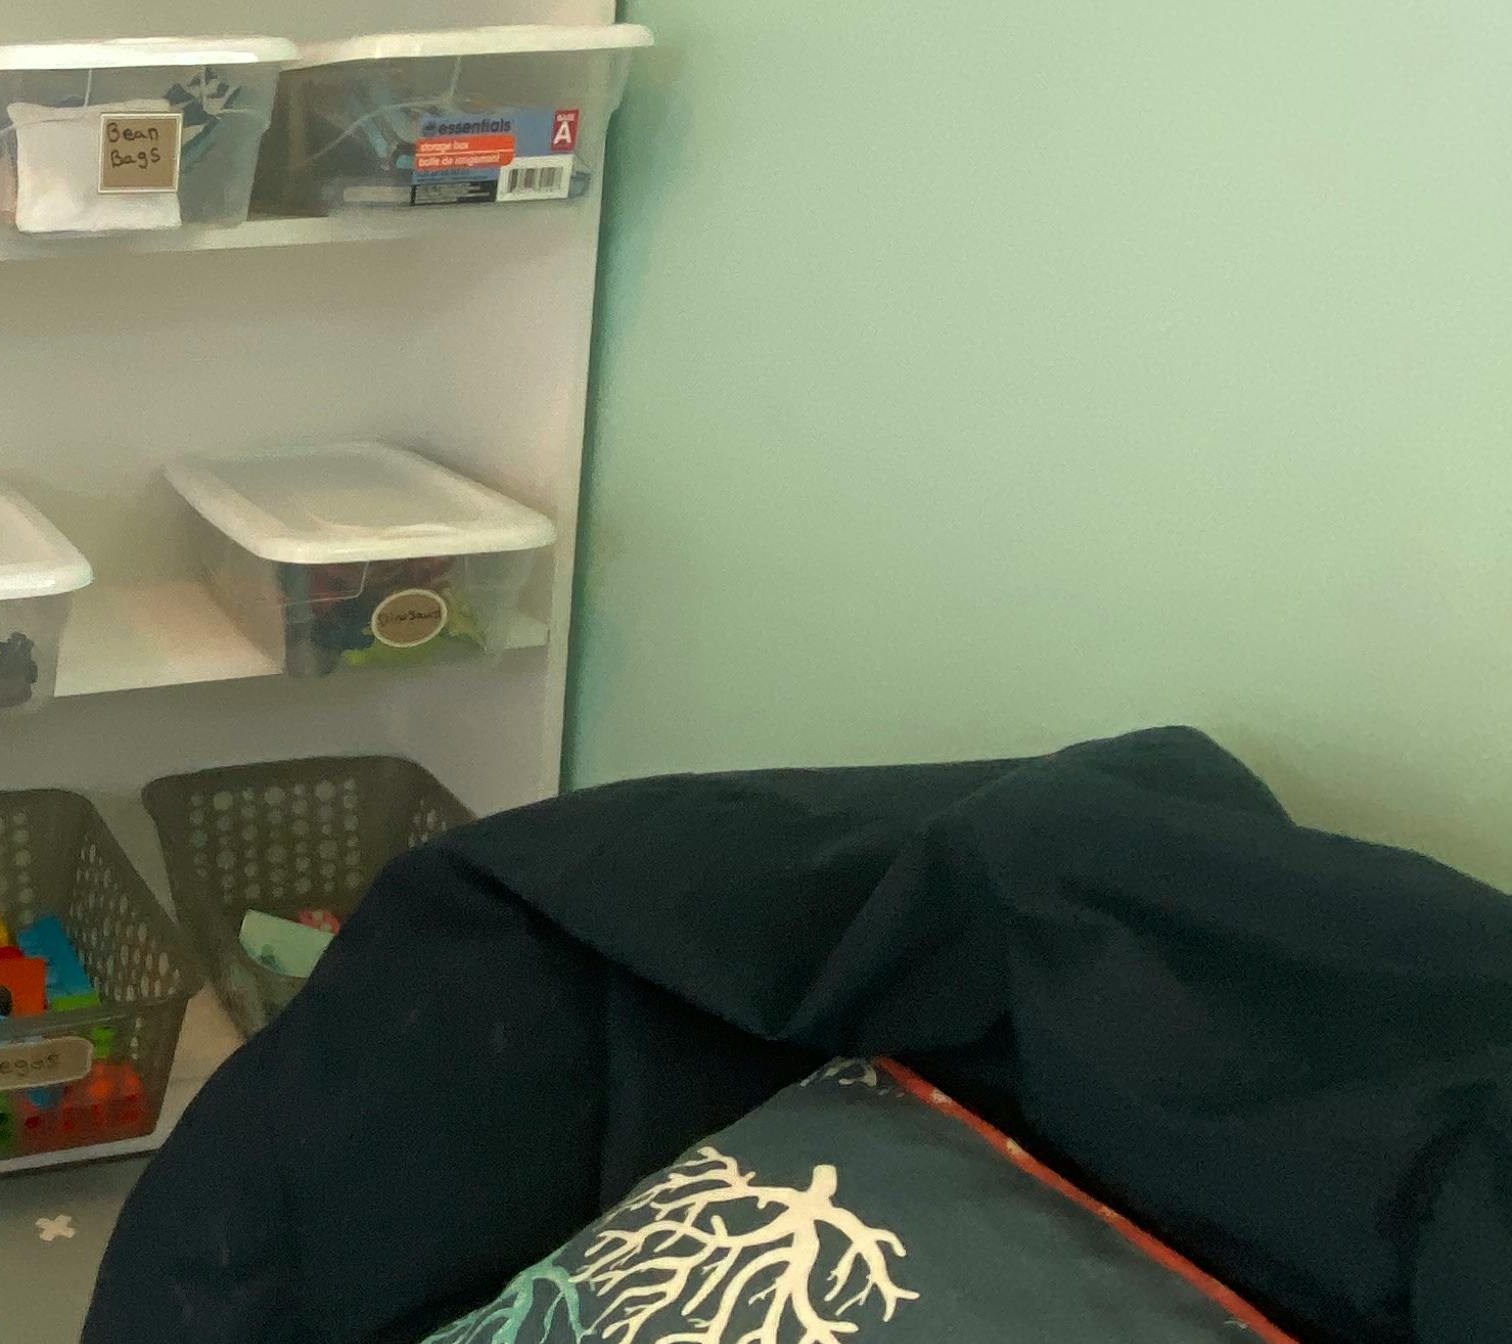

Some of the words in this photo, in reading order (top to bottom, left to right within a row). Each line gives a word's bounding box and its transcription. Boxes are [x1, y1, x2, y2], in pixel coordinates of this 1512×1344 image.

[107, 122, 159, 143] Bean
[438, 117, 512, 135] essentials
[553, 120, 573, 145] A
[110, 147, 161, 170] Bags
